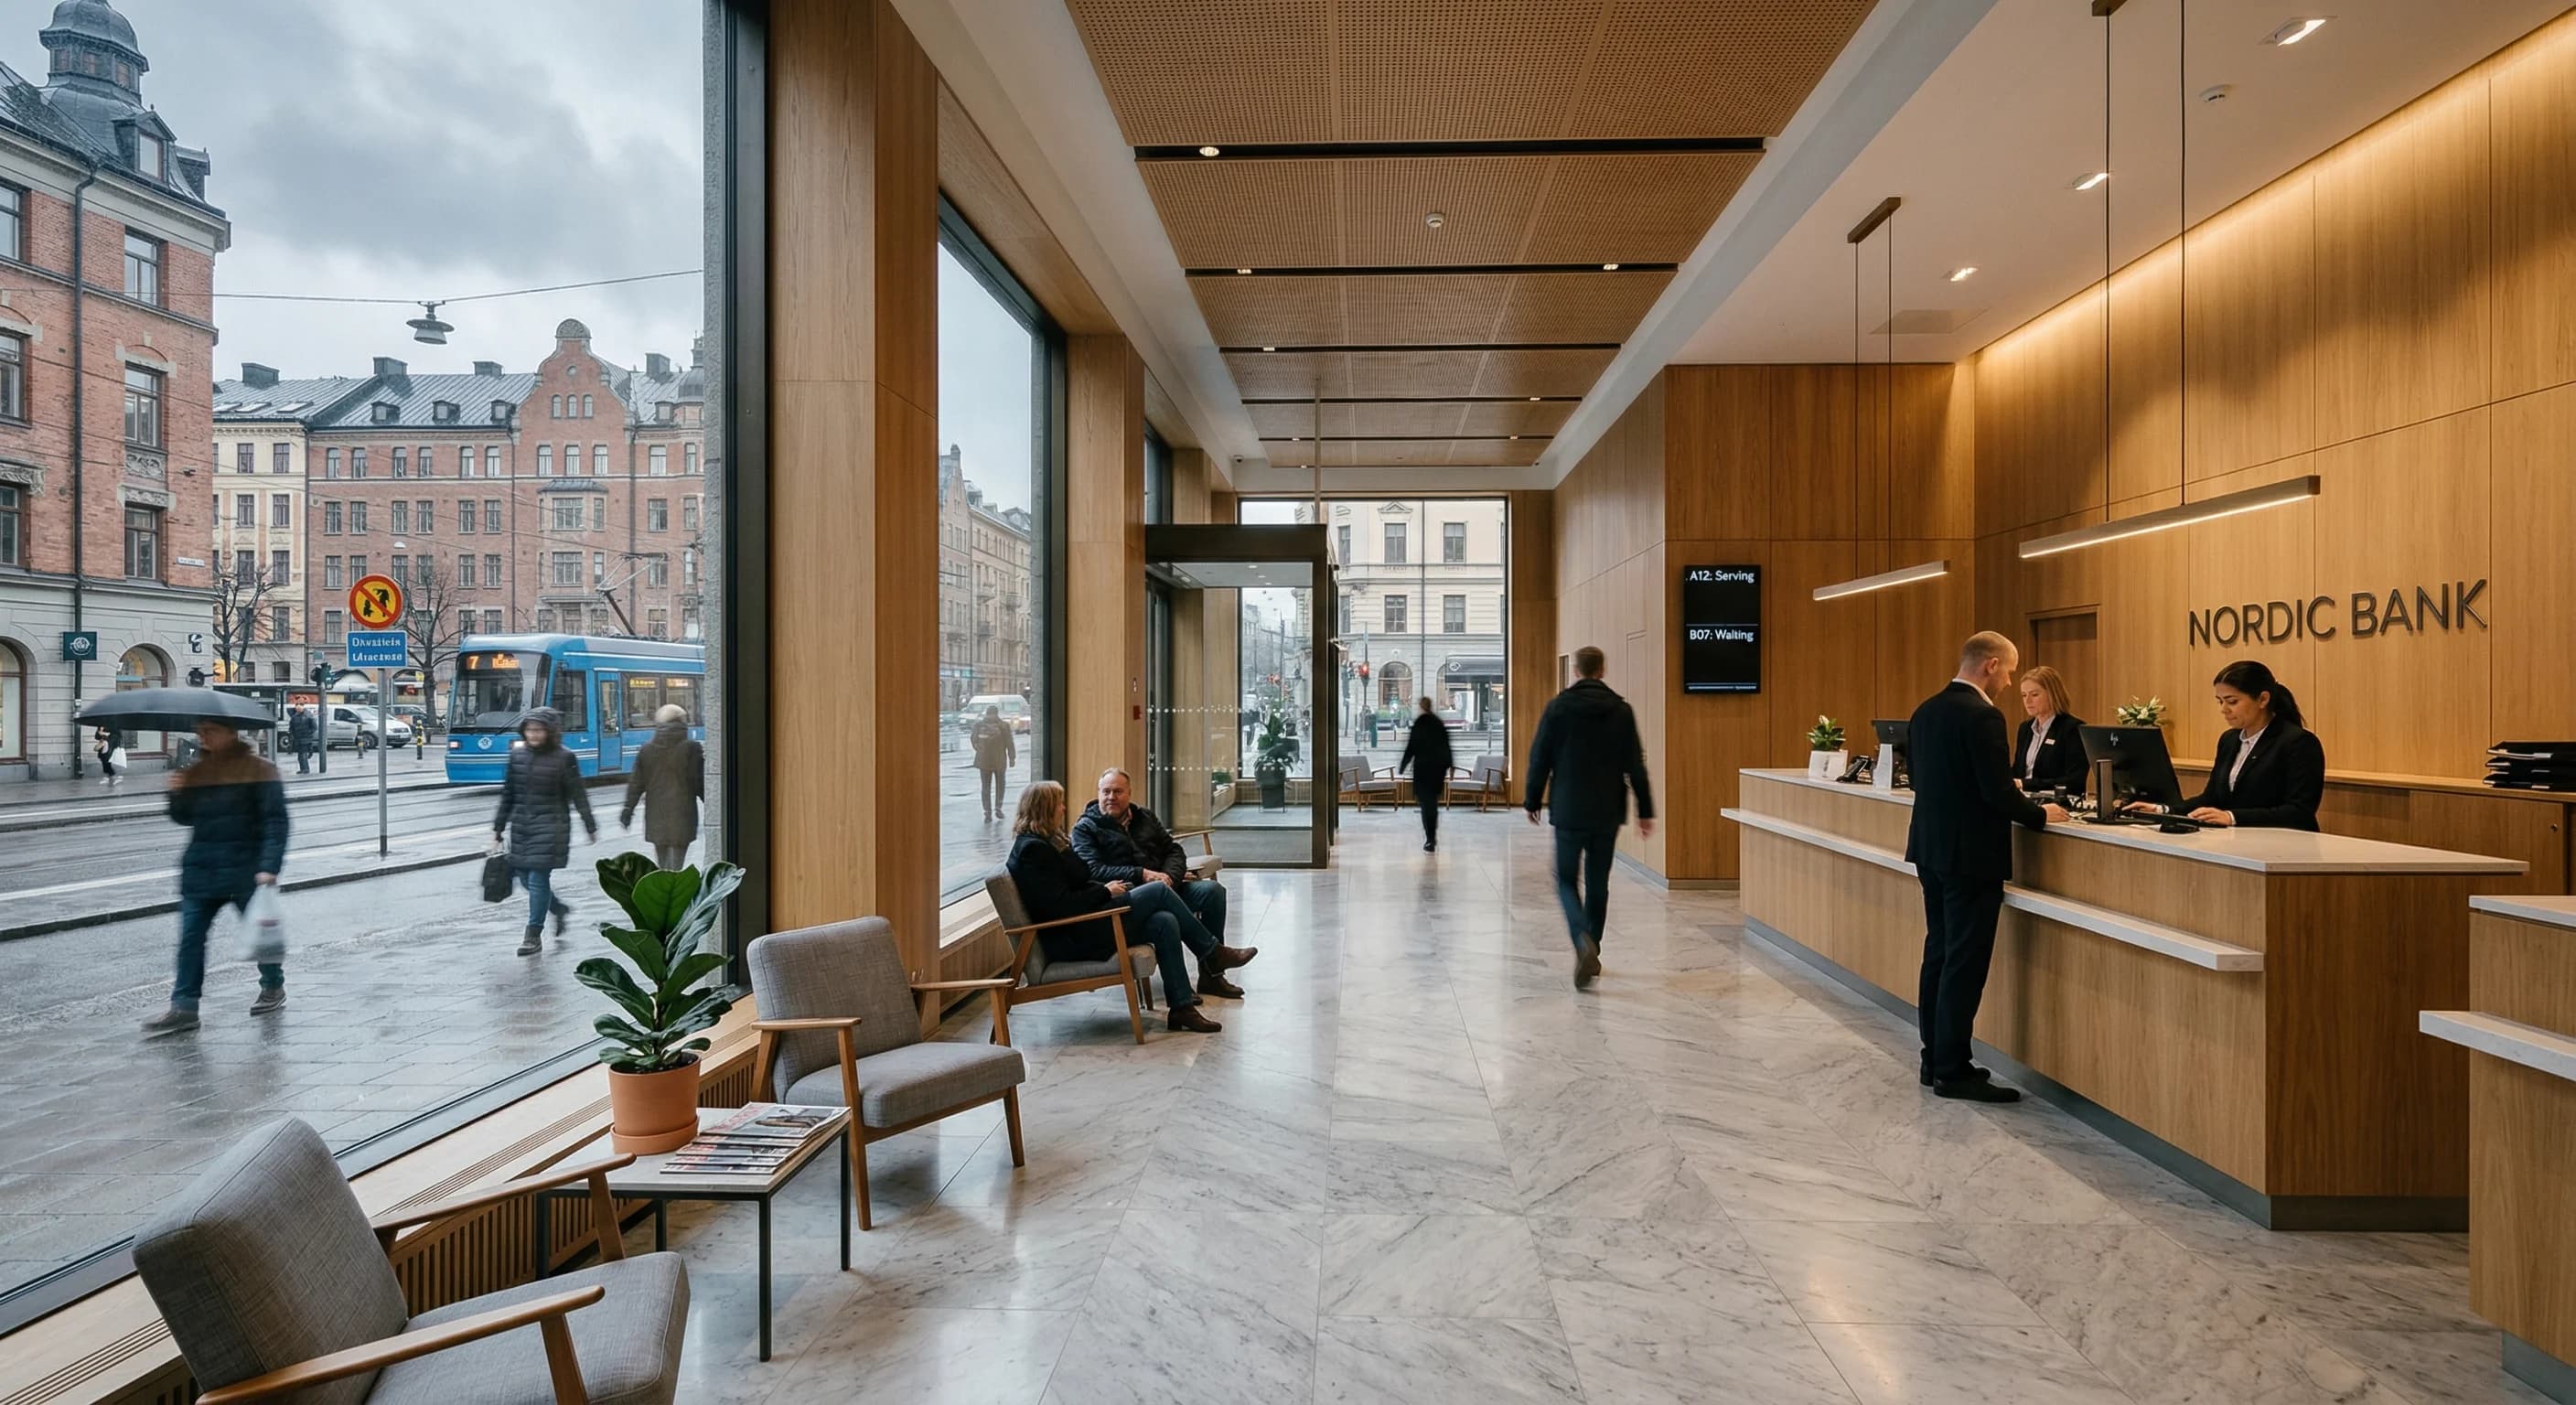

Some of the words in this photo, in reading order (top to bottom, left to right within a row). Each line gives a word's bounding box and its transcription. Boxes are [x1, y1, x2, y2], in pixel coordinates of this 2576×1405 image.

[1690, 570, 1713, 582] A12:
[1715, 569, 1755, 584] Serving
[2189, 595, 2336, 649] NORDIC
[2351, 579, 2486, 638] BANK
[1690, 628, 1713, 640] B07:
[469, 655, 479, 670] 7
